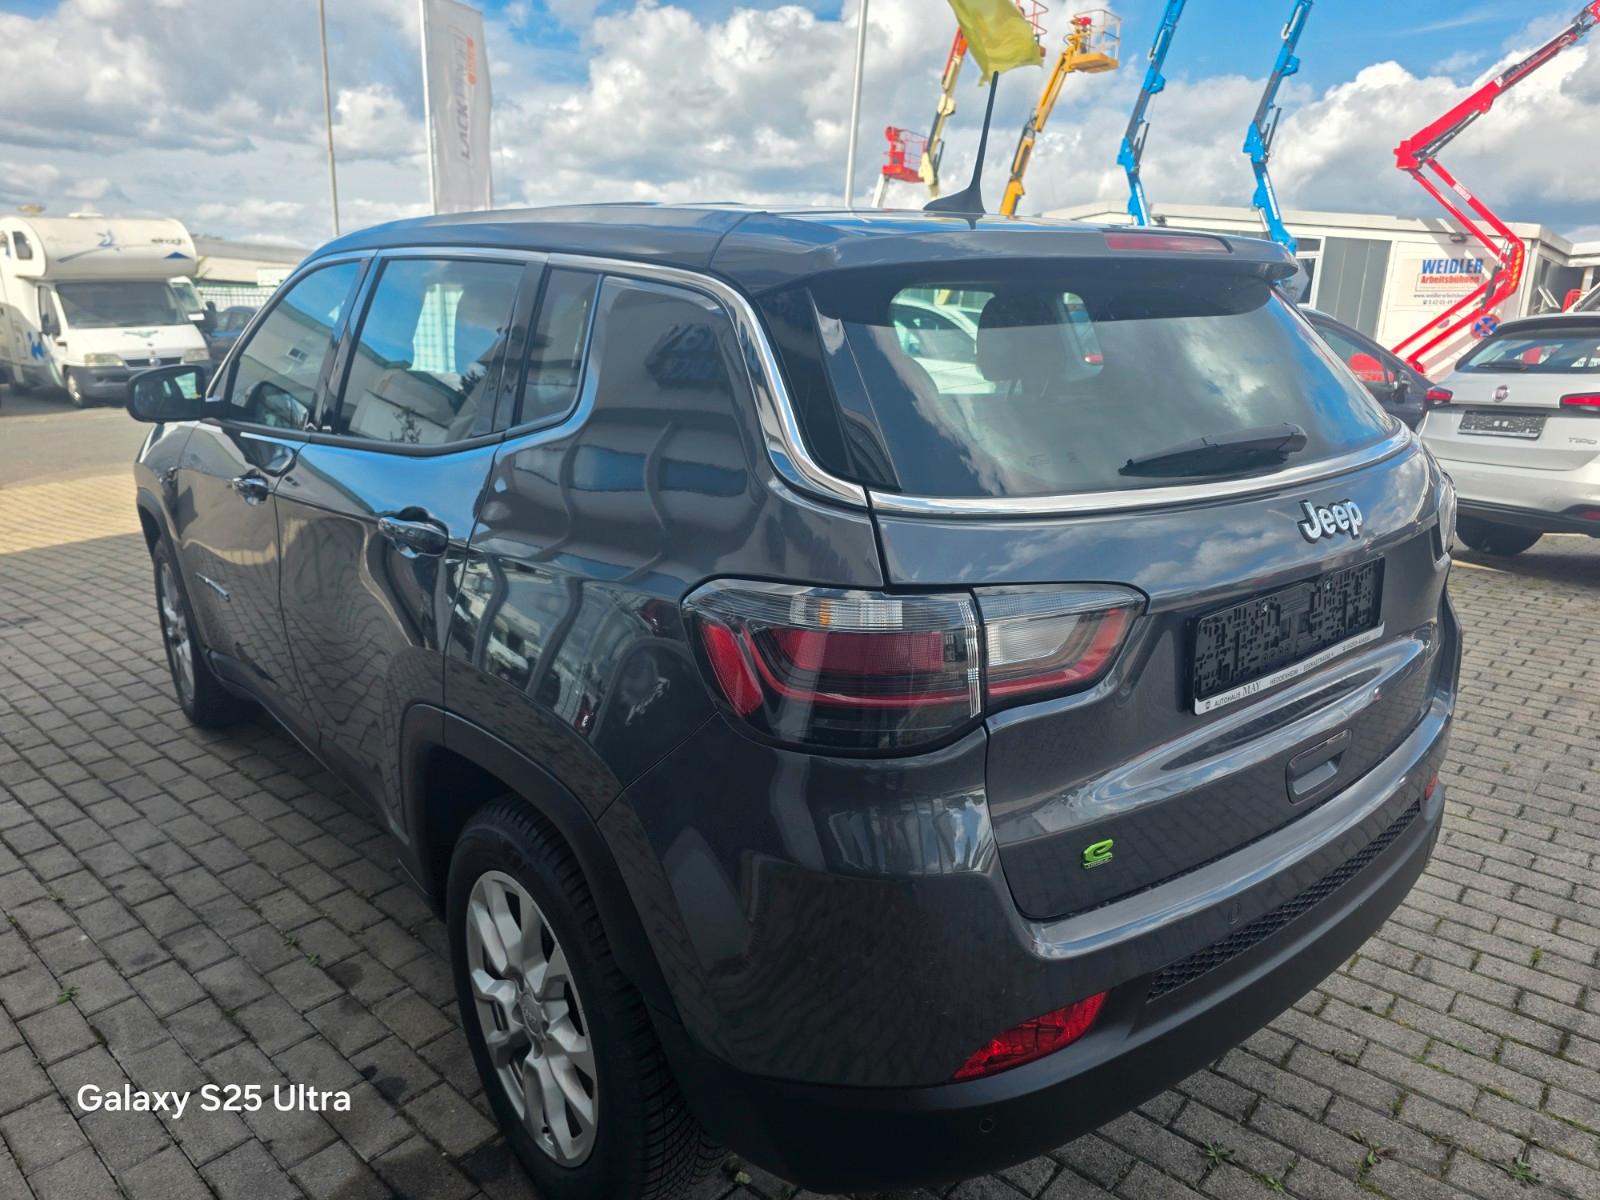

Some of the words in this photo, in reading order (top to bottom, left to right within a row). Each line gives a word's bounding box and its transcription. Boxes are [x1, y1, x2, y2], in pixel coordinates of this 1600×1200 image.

[1422, 258, 1484, 274] WEIDLER
[1298, 499, 1363, 543] Jeep
[1214, 691, 1241, 707] AUTOHAUS
[1242, 681, 1262, 697] MAY
